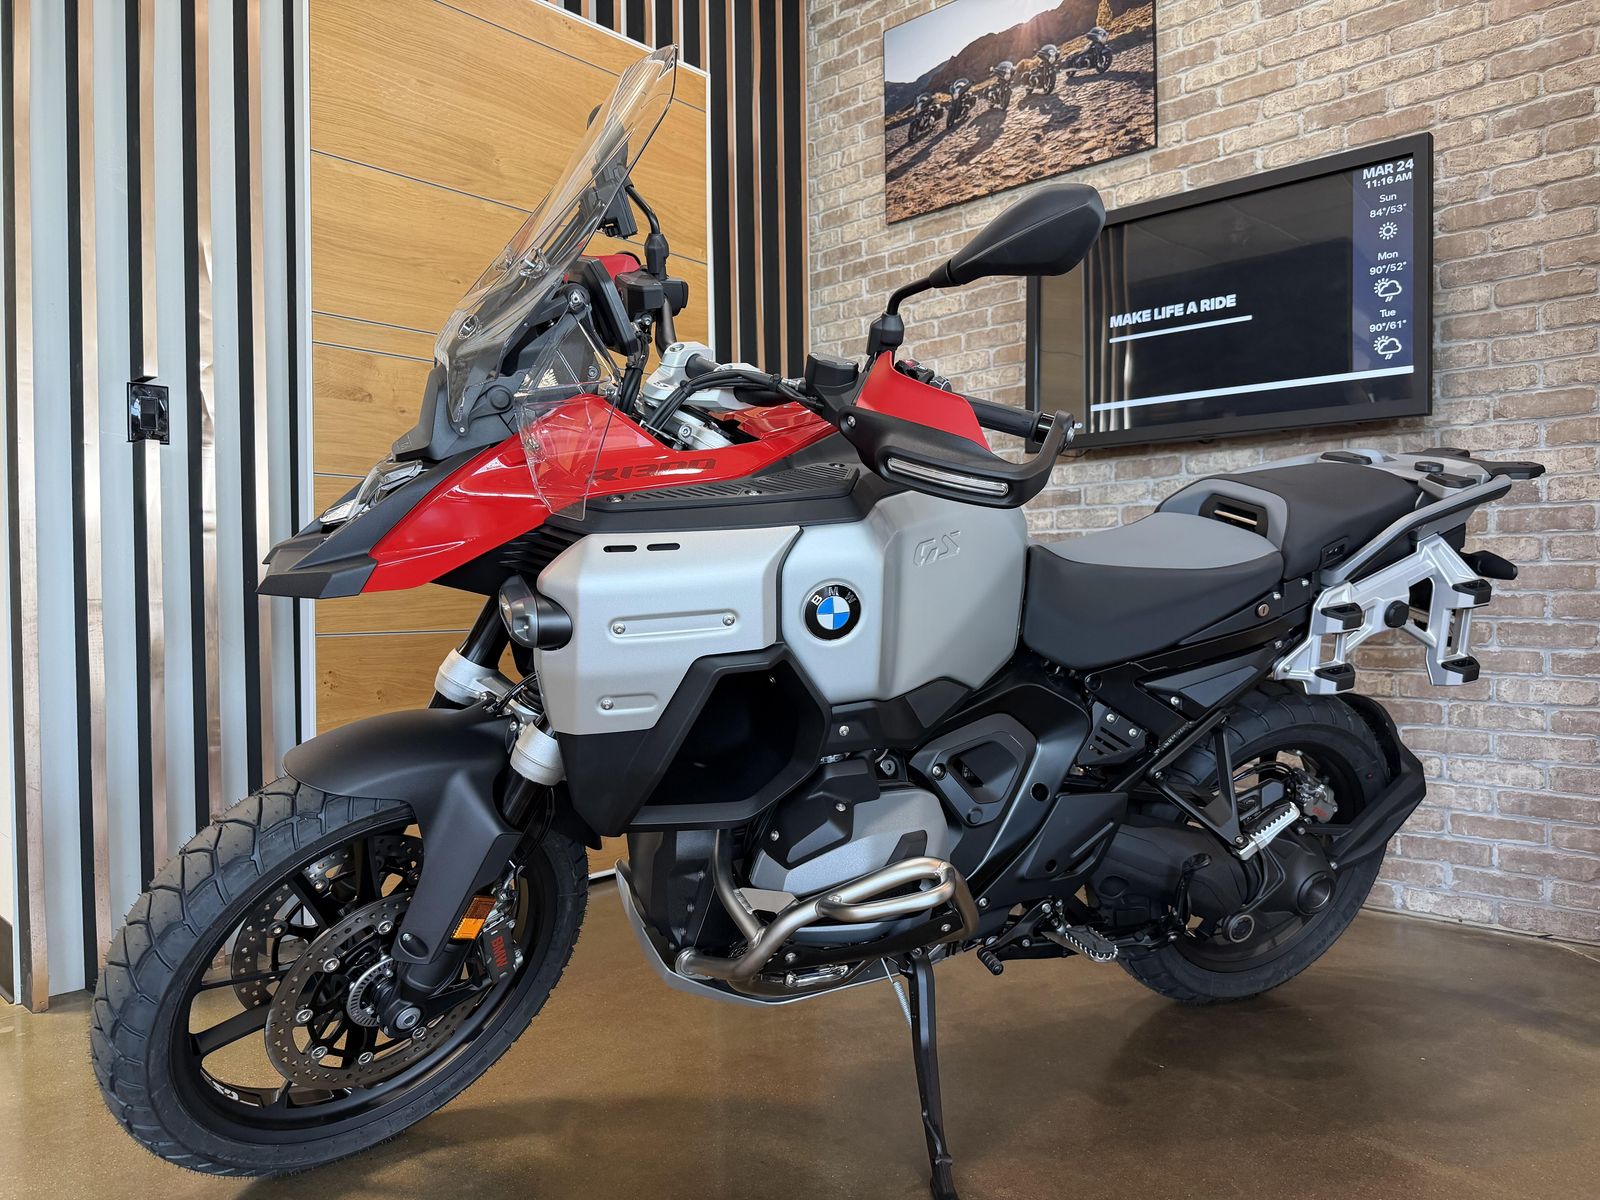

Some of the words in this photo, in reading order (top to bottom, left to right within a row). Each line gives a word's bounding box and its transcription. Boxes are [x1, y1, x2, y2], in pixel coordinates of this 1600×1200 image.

[1363, 163, 1394, 180] MAR
[1396, 158, 1414, 172] 24
[1365, 175, 1394, 189] 11:16
[1395, 171, 1412, 183] AM
[1379, 193, 1397, 203] Sun
[1377, 251, 1399, 261] Mon
[1109, 309, 1152, 329] MAKE
[1153, 303, 1185, 321] LIFE
[1186, 301, 1198, 315] A
[1200, 294, 1237, 312] RIDE
[1380, 309, 1397, 318] Tue
[913, 530, 961, 568] GS
[811, 586, 857, 606] BMW
[491, 936, 508, 968] BMW
